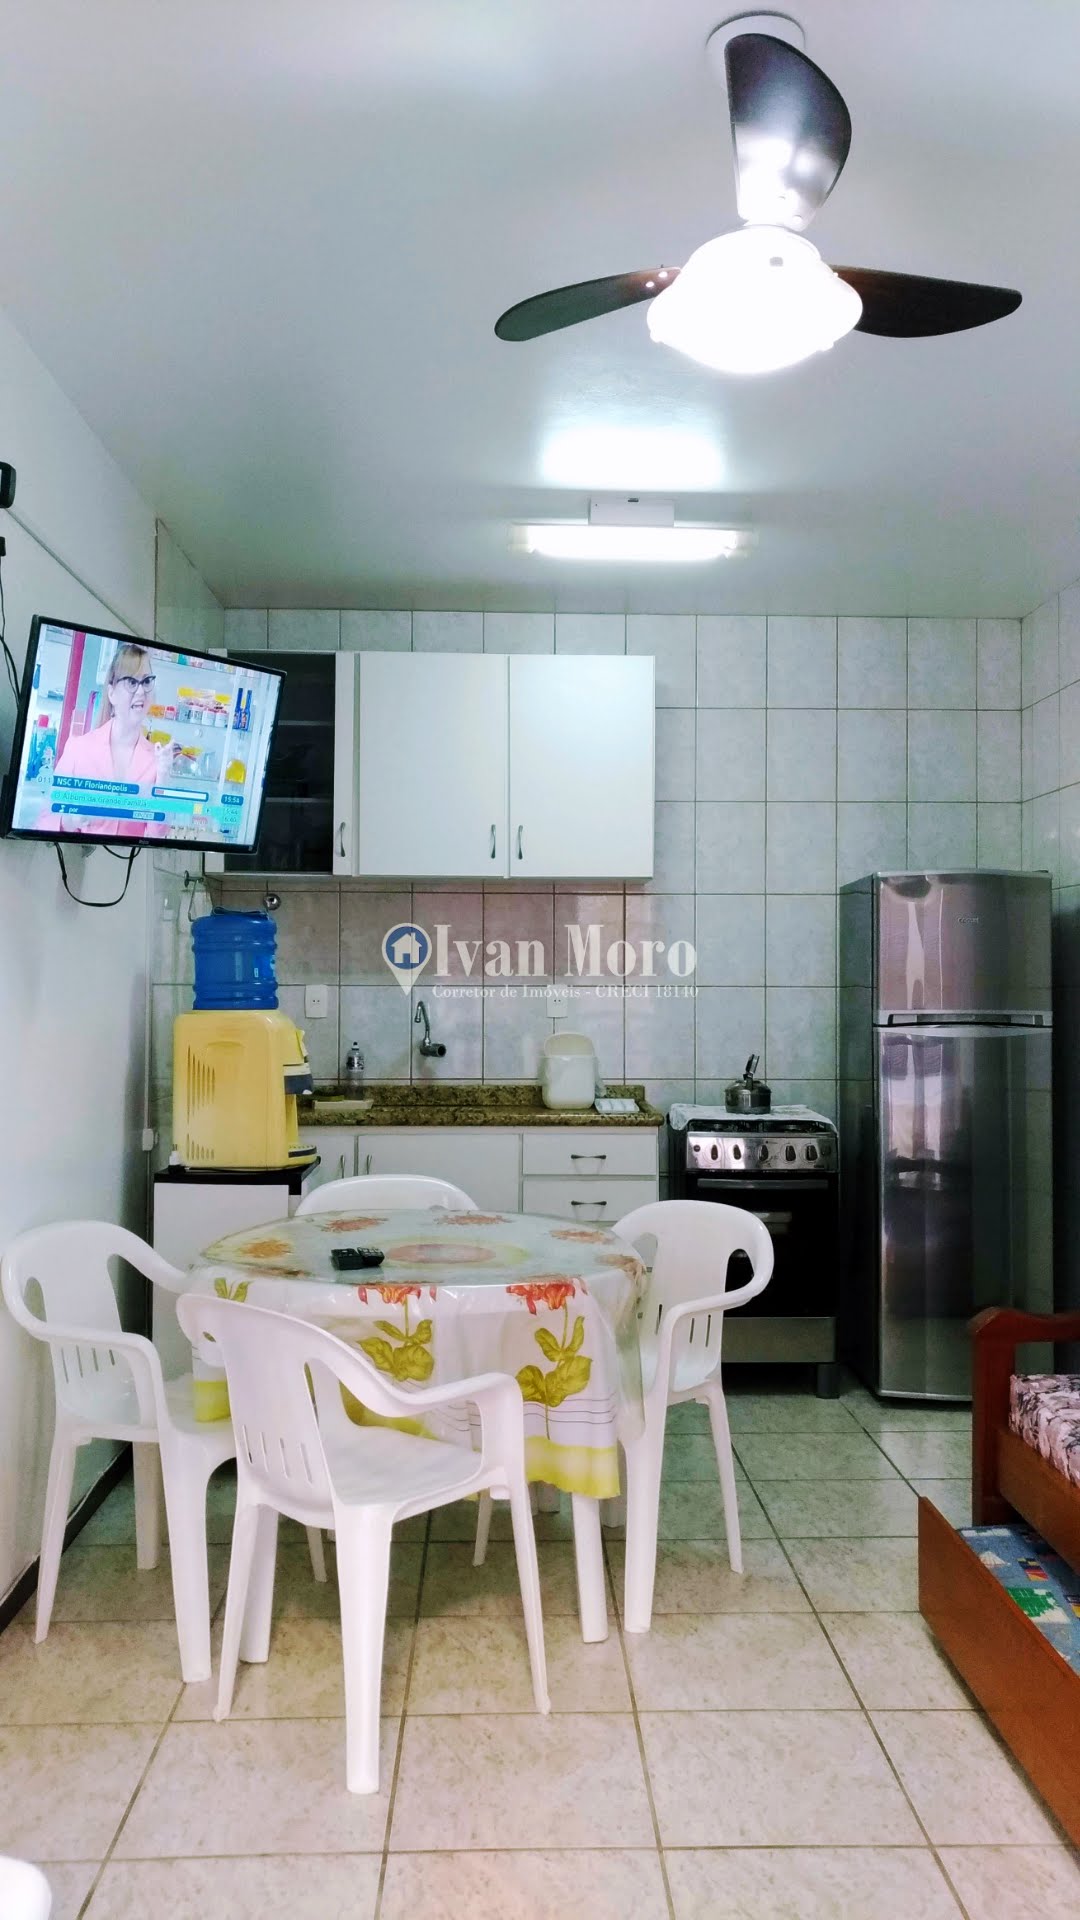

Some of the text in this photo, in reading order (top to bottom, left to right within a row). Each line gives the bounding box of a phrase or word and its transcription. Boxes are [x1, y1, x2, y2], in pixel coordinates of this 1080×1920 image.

[57, 777, 71, 786] NSC
[74, 779, 84, 787] TV
[85, 781, 128, 793] Florianópolis
